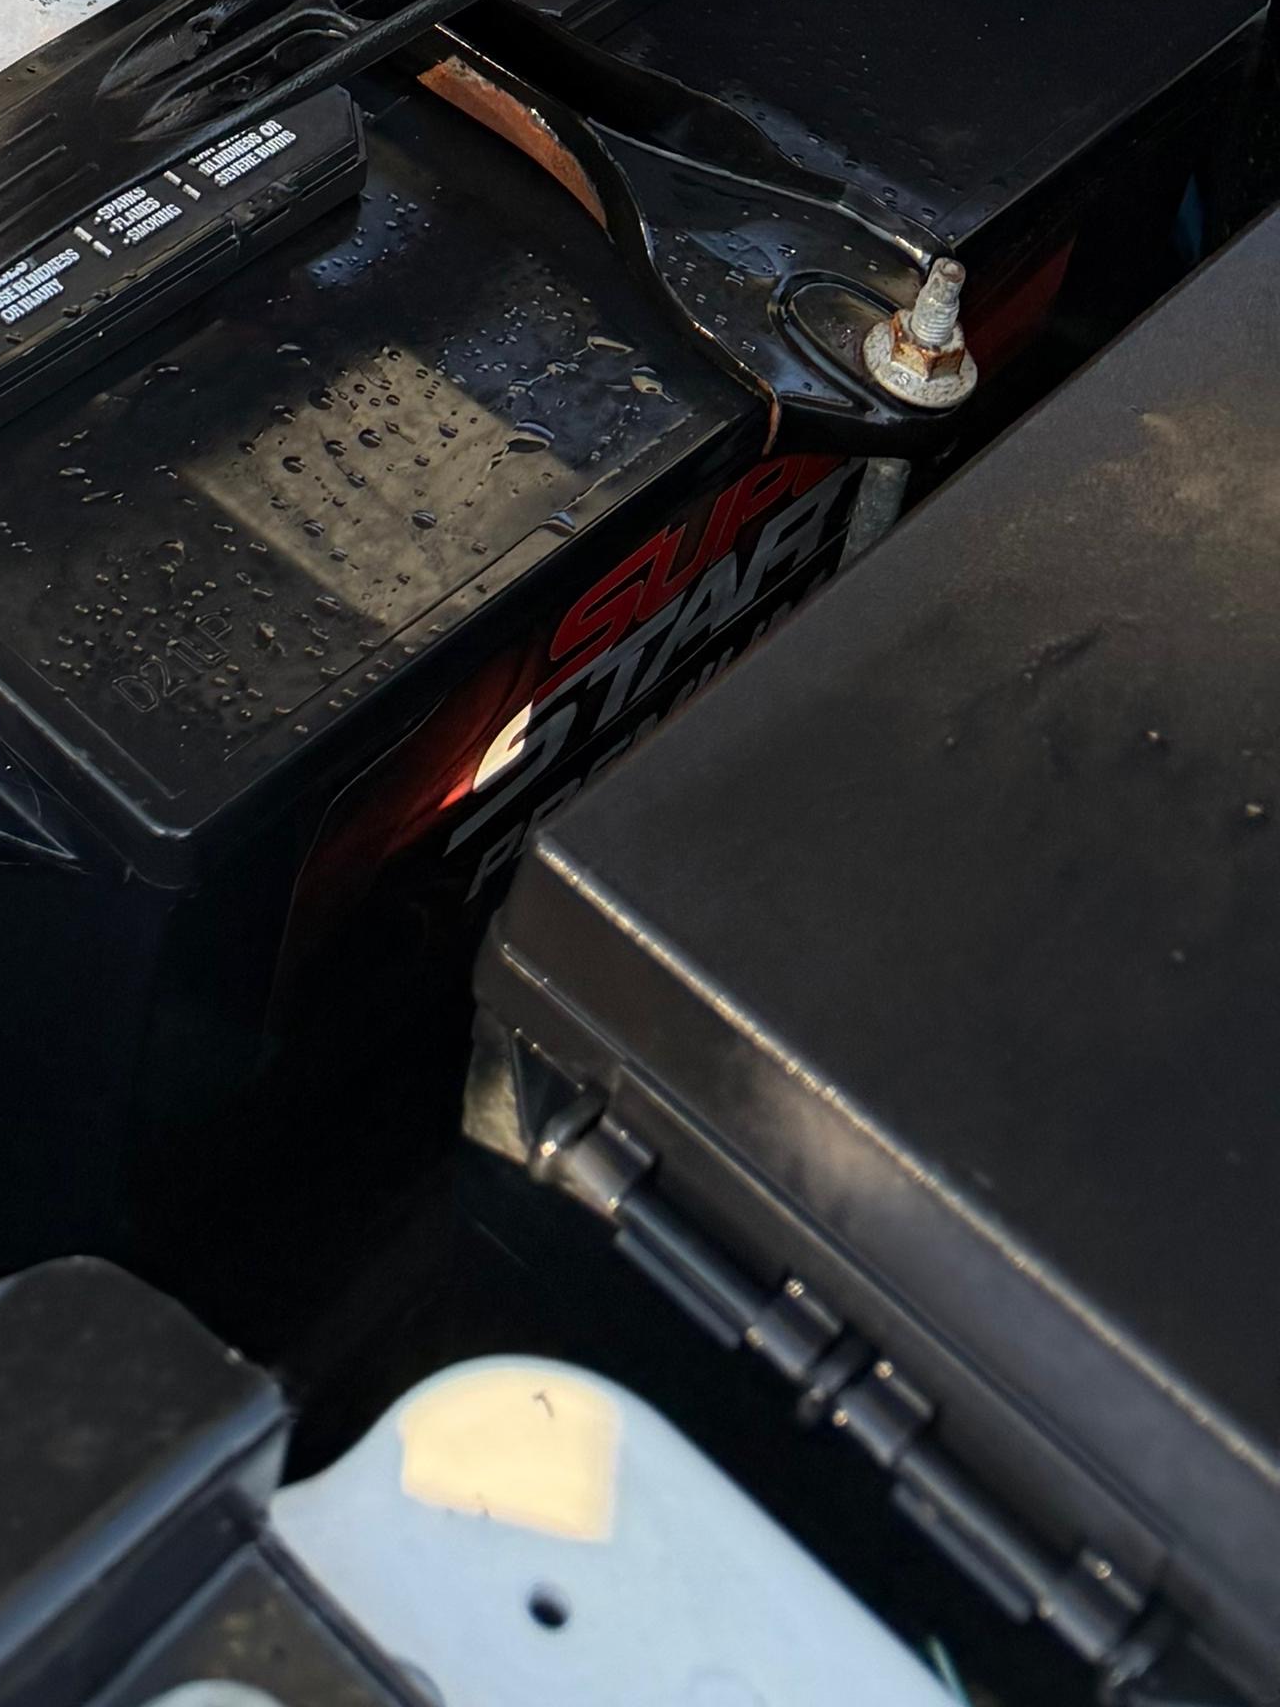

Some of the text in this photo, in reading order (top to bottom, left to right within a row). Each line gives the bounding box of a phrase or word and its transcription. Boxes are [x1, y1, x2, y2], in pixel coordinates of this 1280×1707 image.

[255, 119, 284, 137] OR
[96, 185, 150, 220] SPARKS
[9, 247, 82, 294] BLINDNESS
[444, 457, 868, 857] STAR
